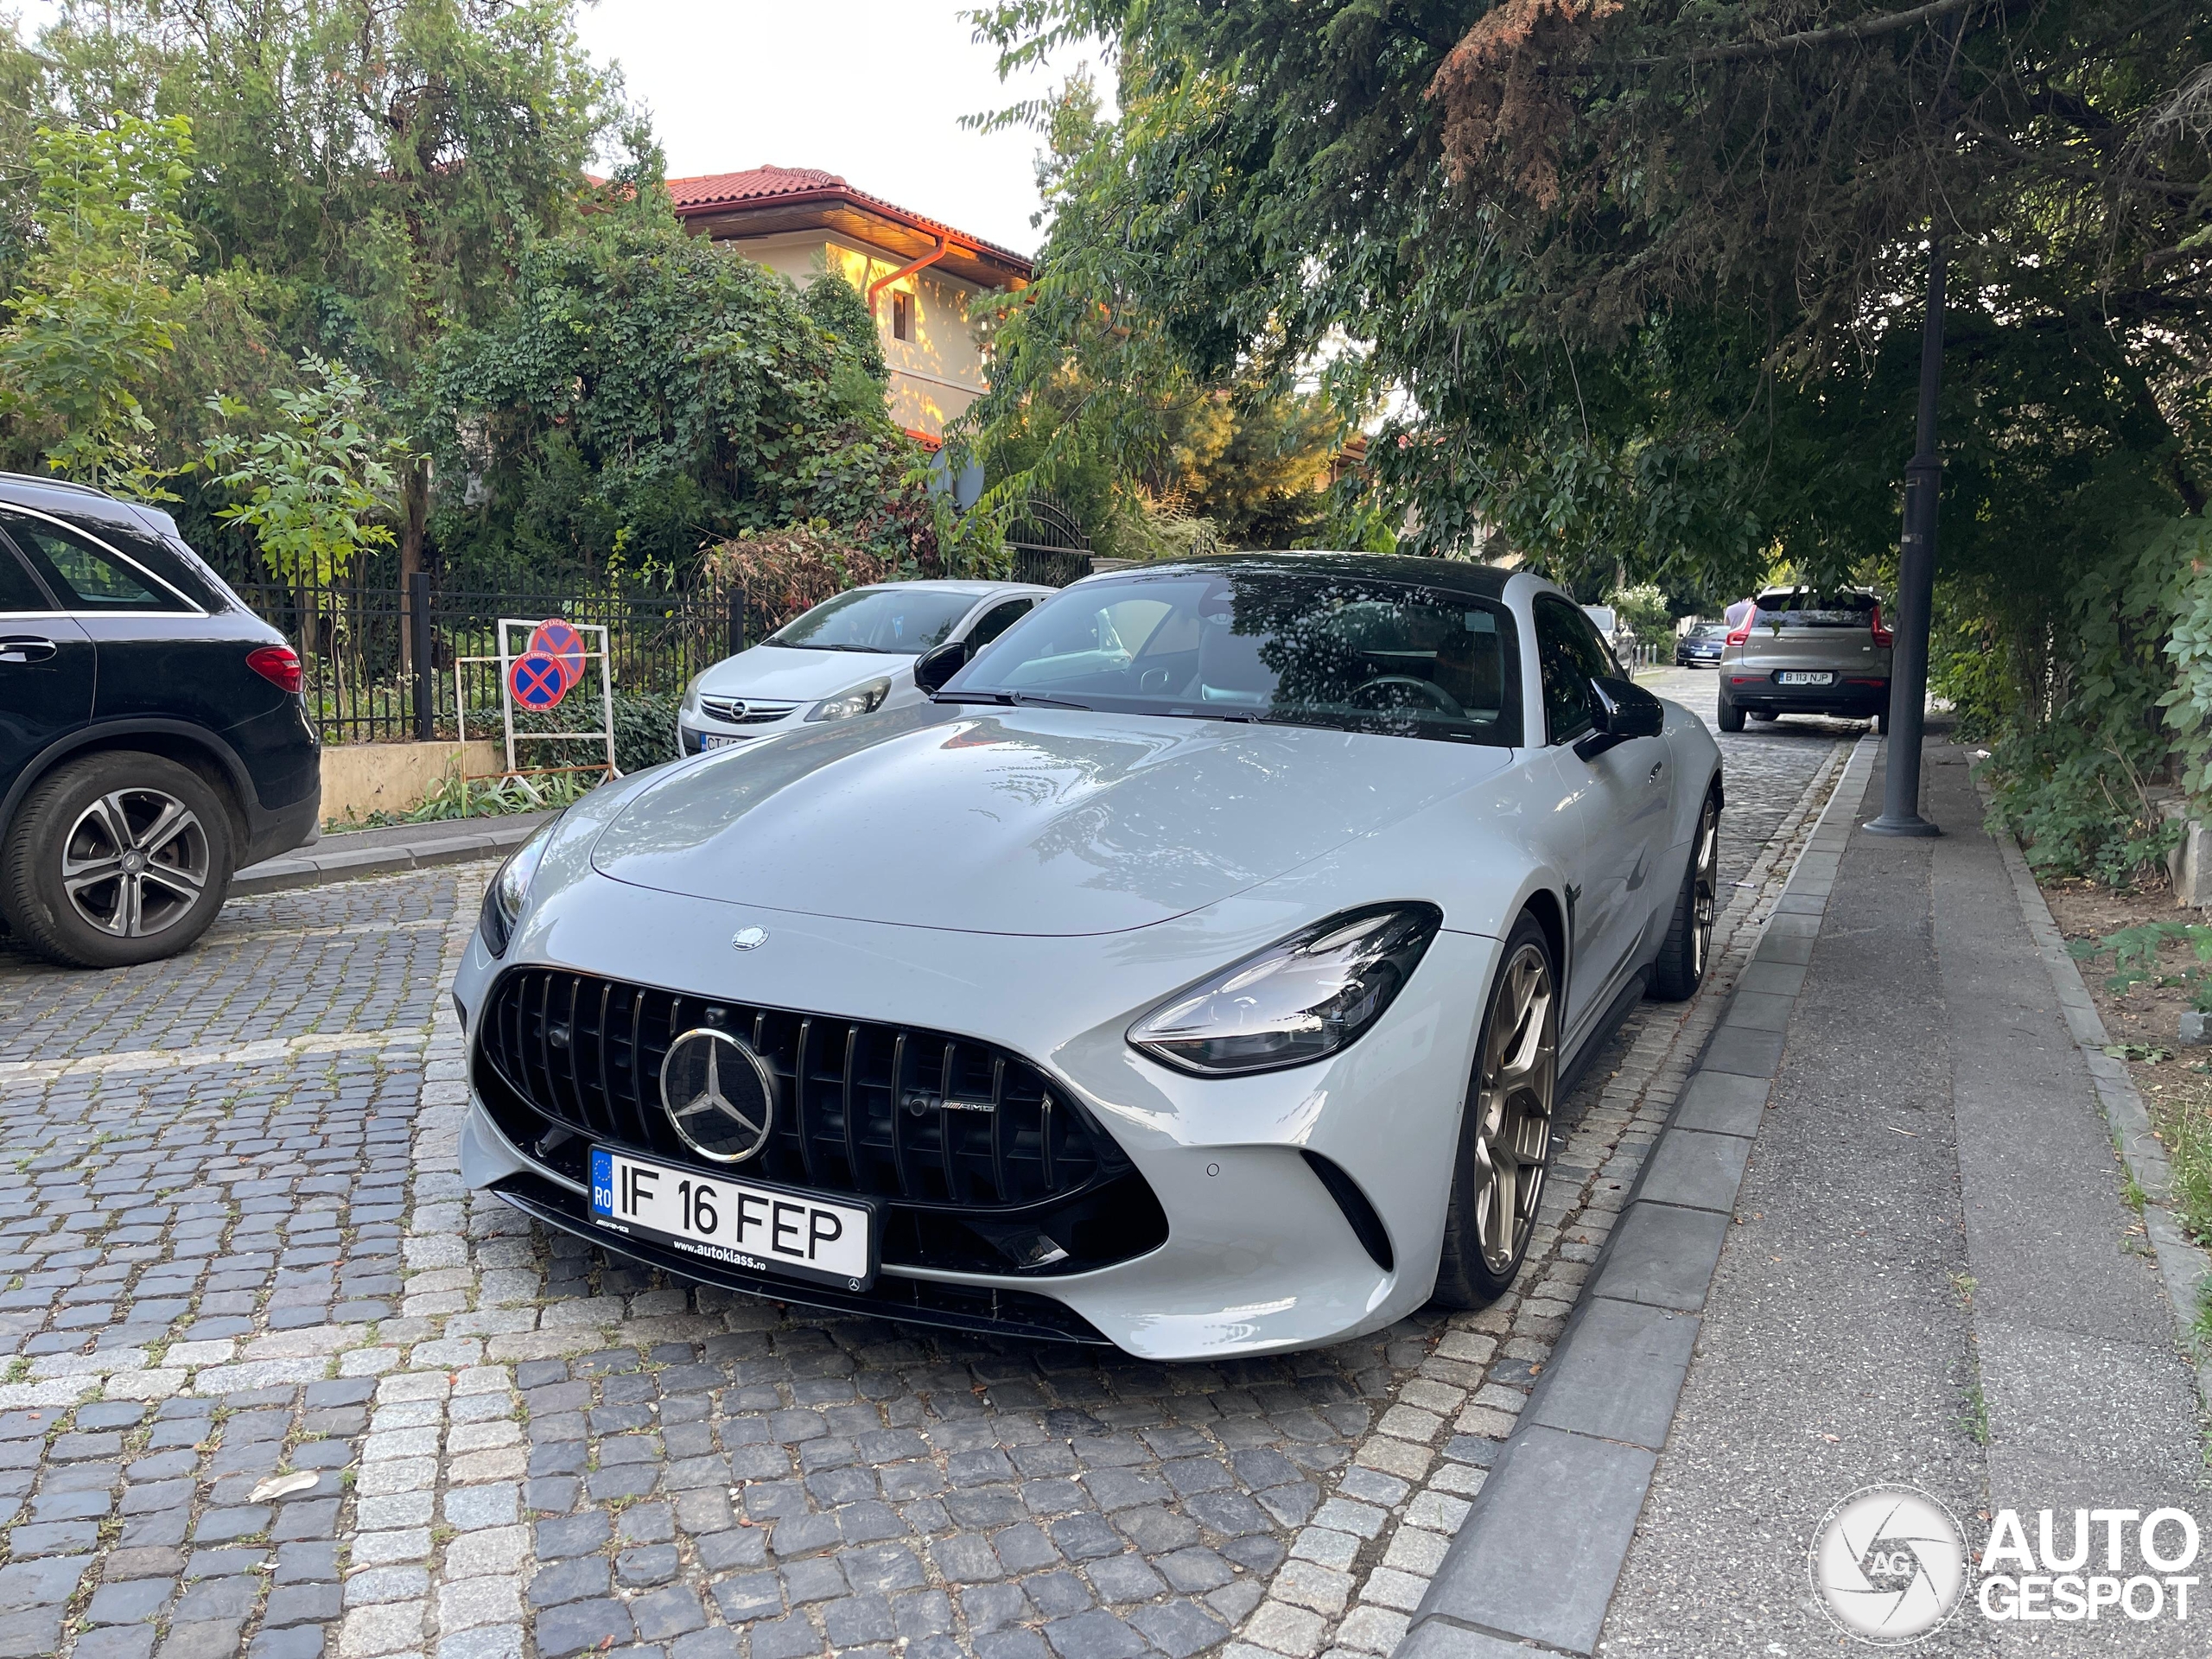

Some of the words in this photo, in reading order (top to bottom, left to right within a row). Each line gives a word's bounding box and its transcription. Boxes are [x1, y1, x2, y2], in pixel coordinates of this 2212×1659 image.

[549, 620, 574, 633] EXCEPTIA
[531, 652, 553, 662] EXCEPTIA
[1796, 673, 1808, 682] 113
[1810, 673, 1828, 682] NJP
[594, 1185, 612, 1208] RO
[621, 1165, 659, 1216] IF
[678, 1180, 718, 1235] 16
[736, 1192, 842, 1260] FEP
[674, 1241, 766, 1270] www.autoklass.ro
